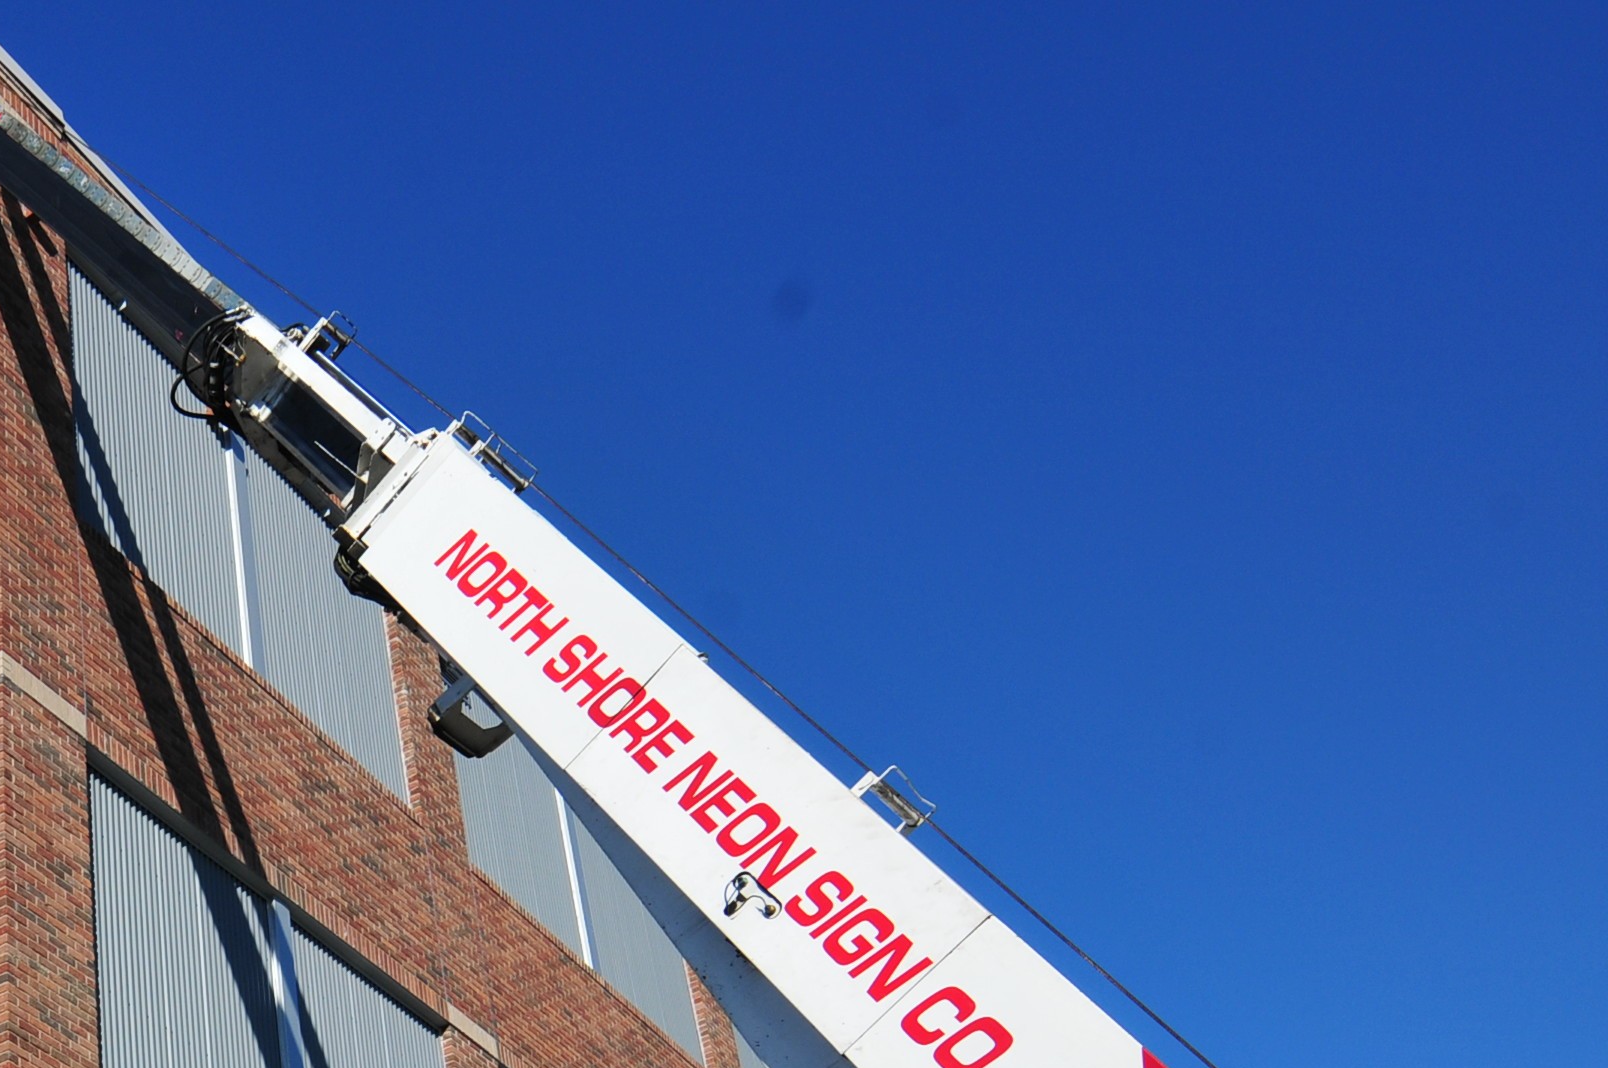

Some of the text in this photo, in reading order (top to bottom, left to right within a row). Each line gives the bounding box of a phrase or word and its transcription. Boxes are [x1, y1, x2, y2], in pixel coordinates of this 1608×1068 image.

[434, 529, 570, 656] NORTH
[543, 634, 696, 774] SHORE
[663, 751, 818, 890] NEON
[784, 870, 934, 1003] SIGN
